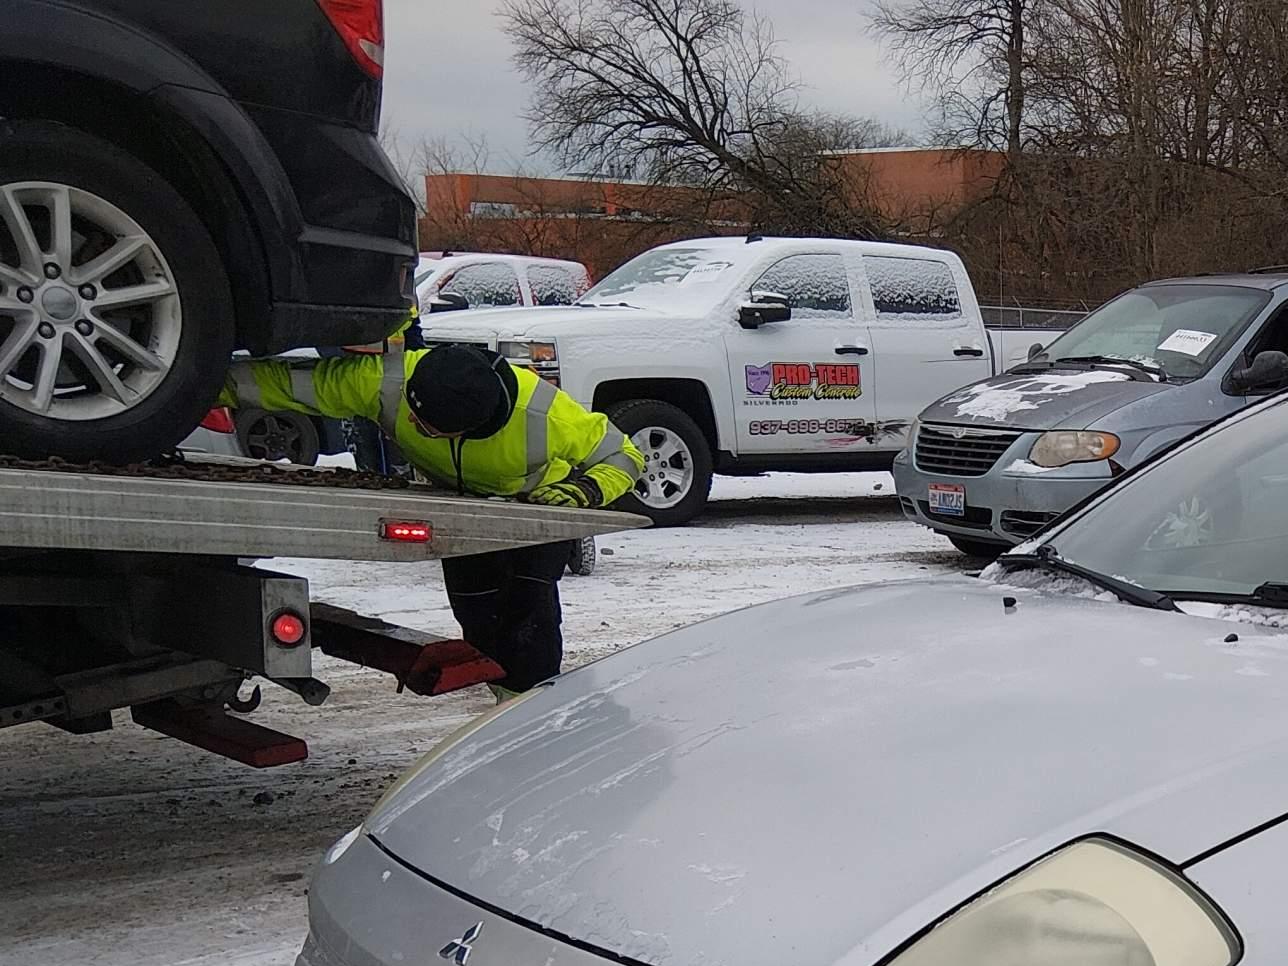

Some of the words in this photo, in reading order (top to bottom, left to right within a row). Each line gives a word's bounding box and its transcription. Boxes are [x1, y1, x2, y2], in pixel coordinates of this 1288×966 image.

[771, 363, 860, 386] PRO-TECH
[770, 382, 814, 400] Custom
[814, 382, 862, 400] Concrete
